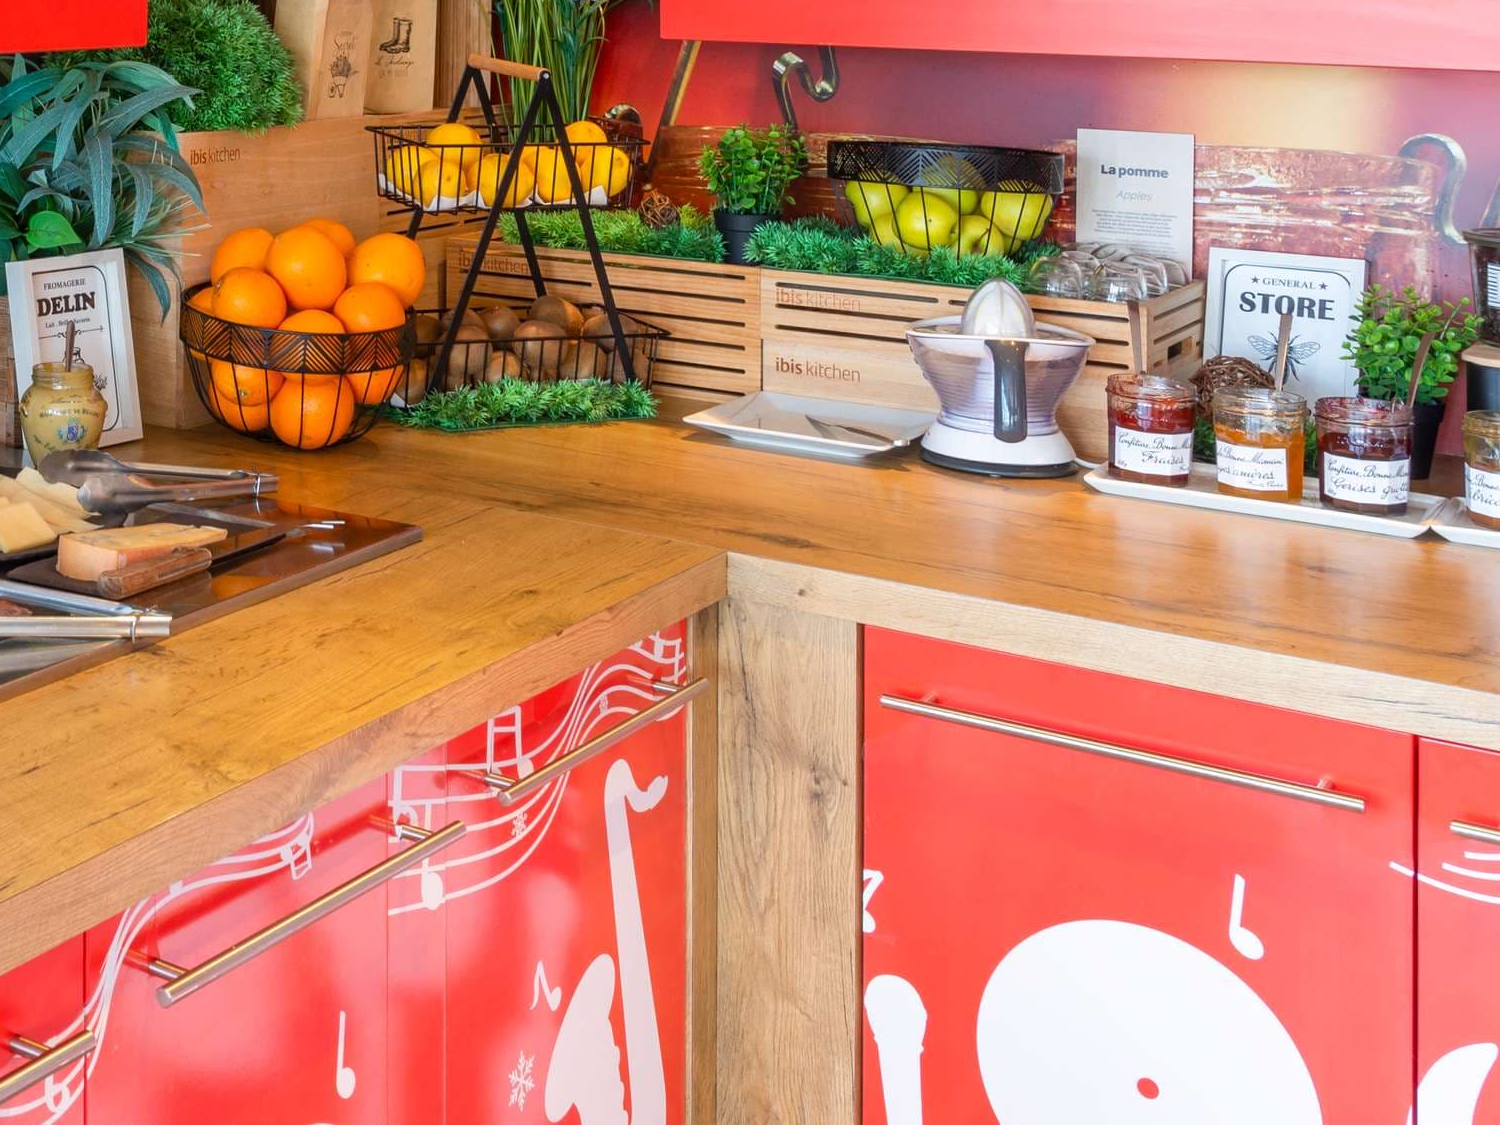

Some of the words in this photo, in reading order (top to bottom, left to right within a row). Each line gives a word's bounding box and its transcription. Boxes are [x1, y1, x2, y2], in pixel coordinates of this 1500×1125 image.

[190, 149, 207, 165] ibis
[208, 147, 241, 163] kitchen
[1100, 164, 1116, 175] La
[1118, 166, 1169, 179] pomme
[1116, 190, 1153, 203] Apples
[43, 278, 85, 291] FROMAGERIE
[1262, 277, 1317, 290] GENERAL
[36, 291, 96, 317] DELIN
[776, 288, 804, 305] ibis
[806, 291, 861, 313] kitchen
[1239, 291, 1335, 321] STORE
[776, 357, 803, 375] ibis
[806, 360, 861, 382] kitchen
[1331, 477, 1376, 493] Cerises
